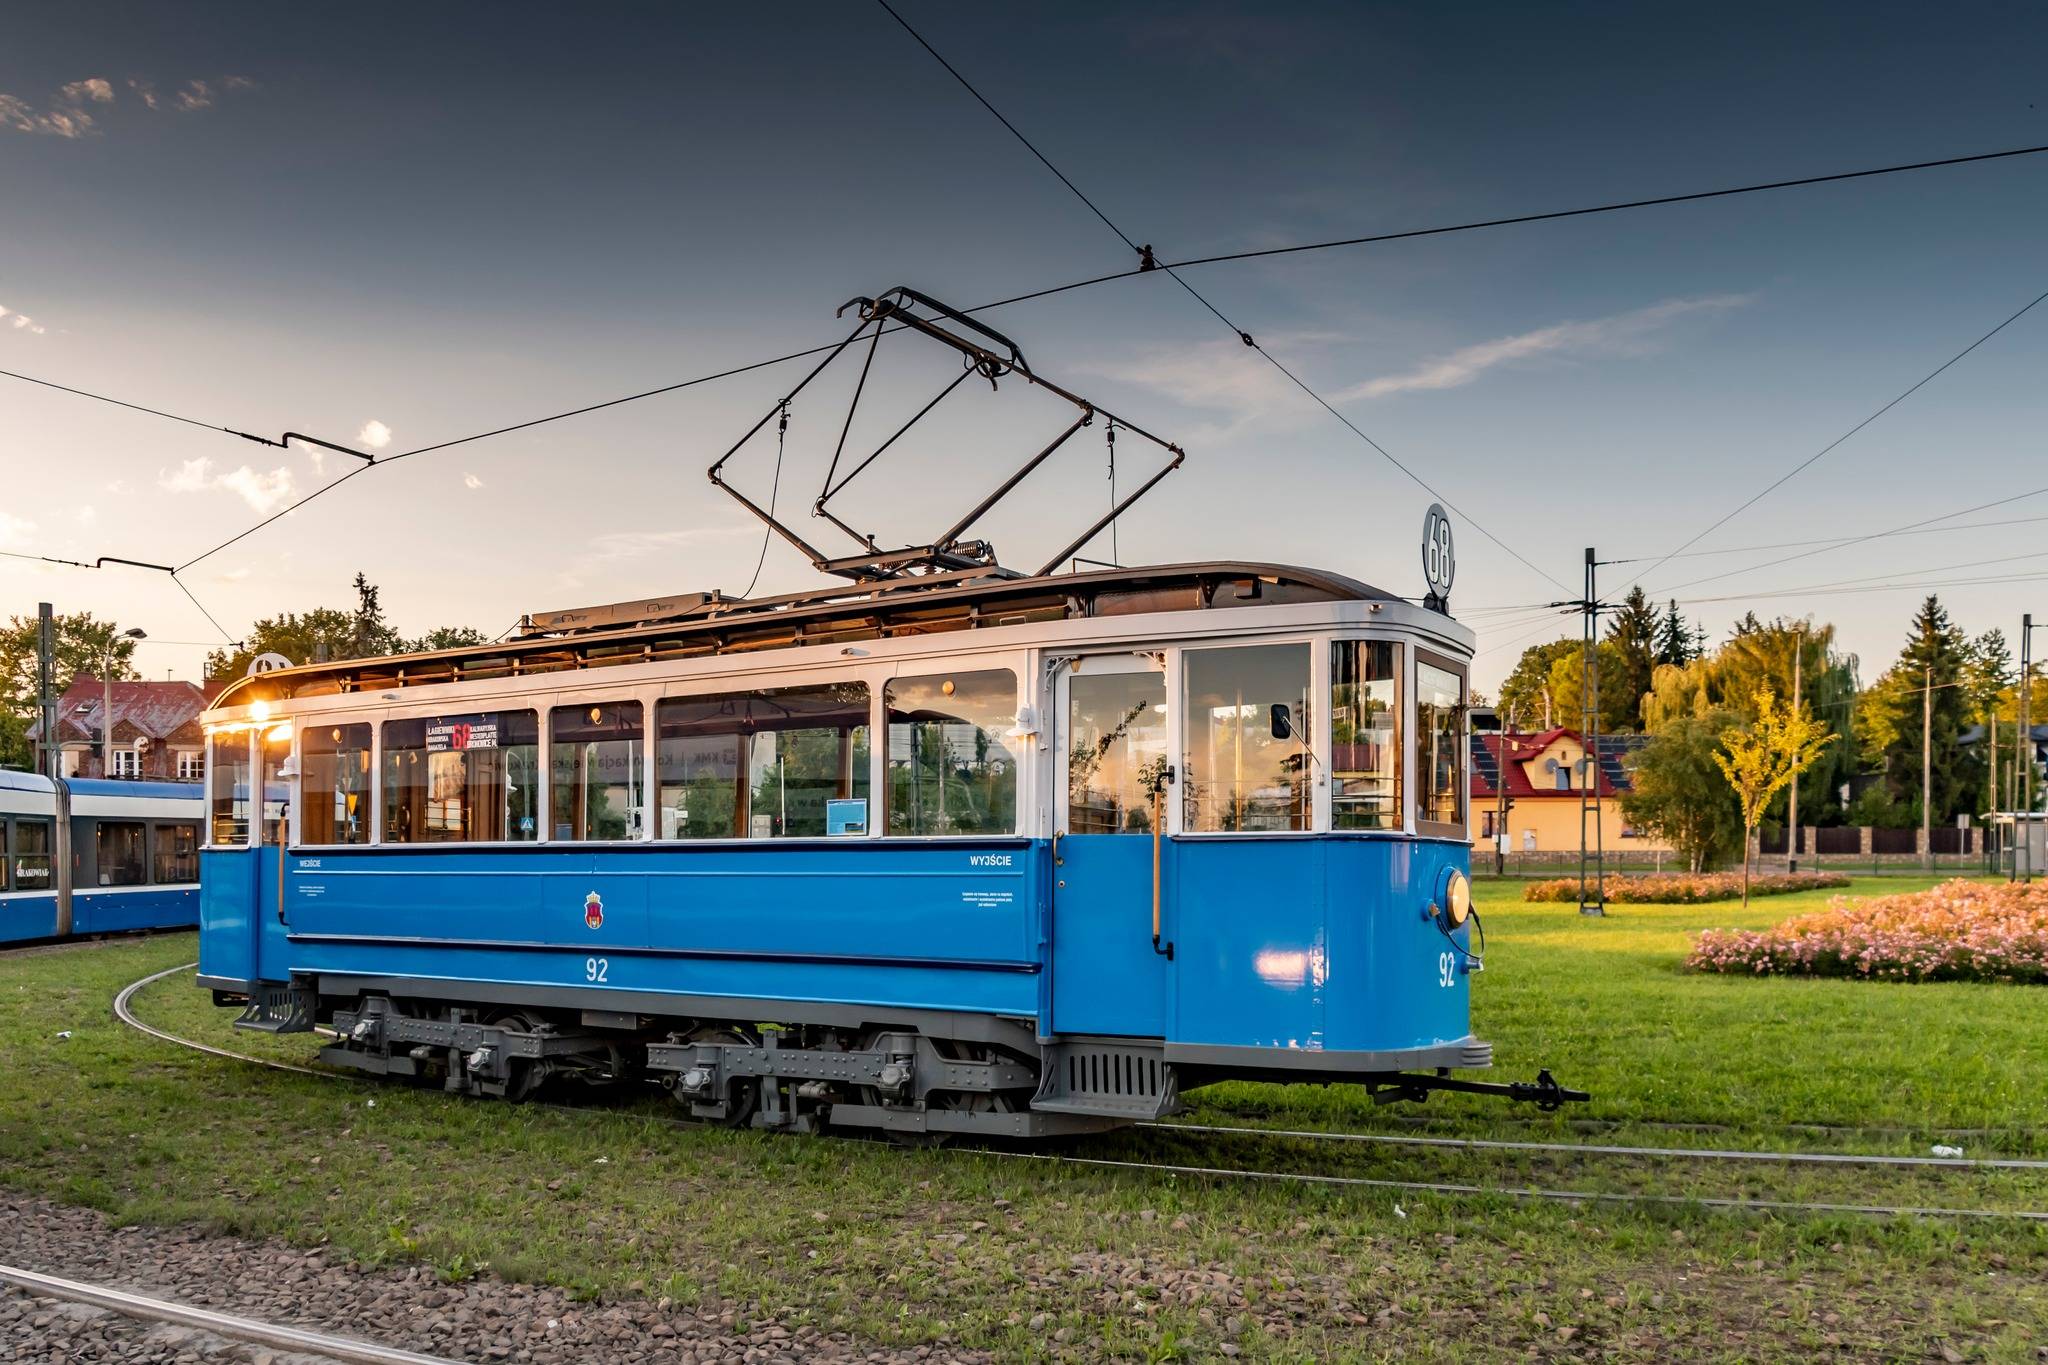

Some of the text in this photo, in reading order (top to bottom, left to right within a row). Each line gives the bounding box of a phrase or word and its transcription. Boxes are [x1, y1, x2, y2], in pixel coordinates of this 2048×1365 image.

[1428, 513, 1450, 588] 68
[453, 722, 471, 750] 68
[970, 854, 1012, 866] WYJŚCIE
[586, 957, 608, 982] 92
[1439, 951, 1455, 988] 92
